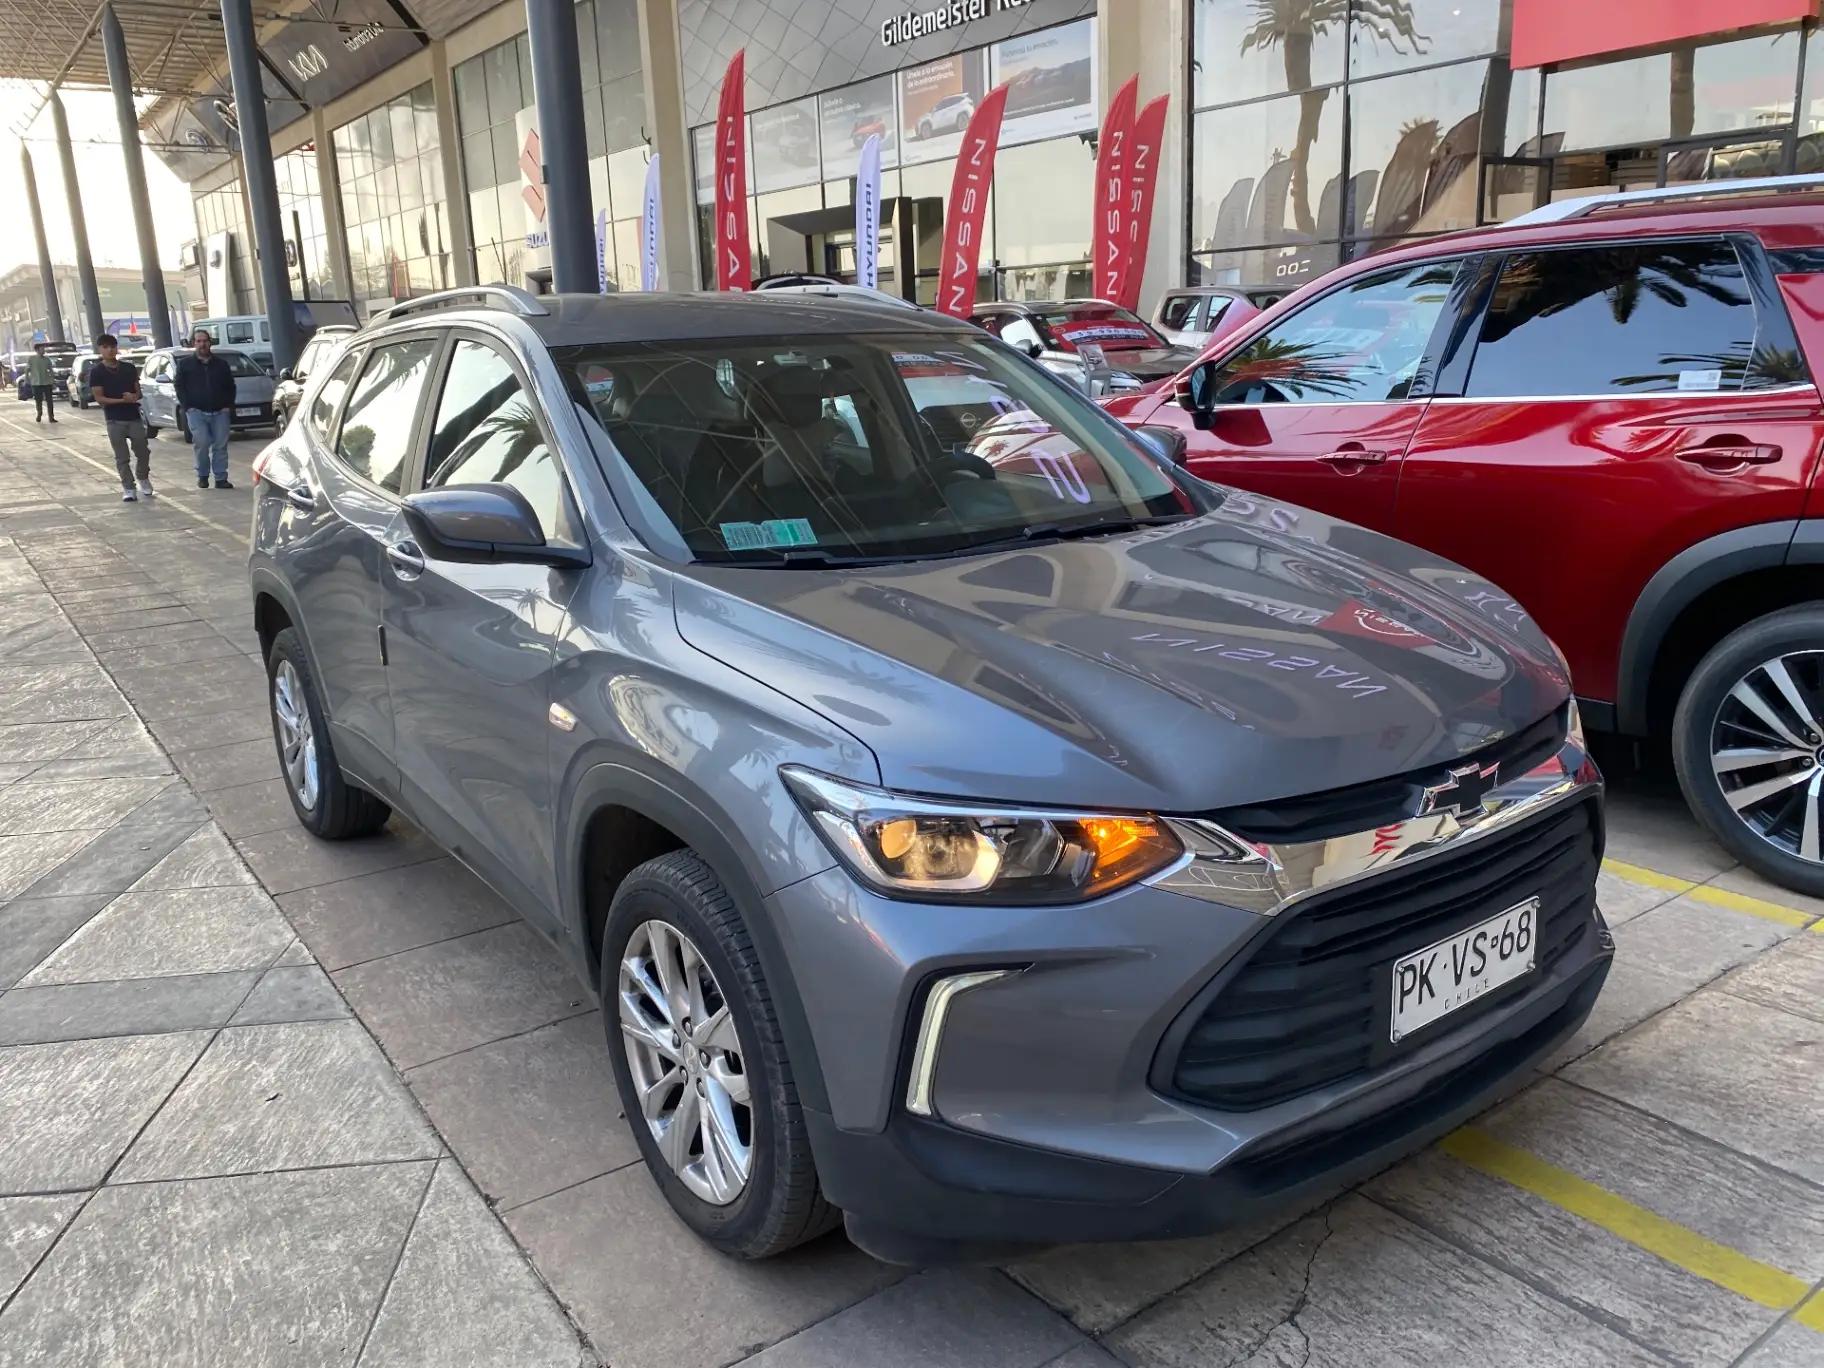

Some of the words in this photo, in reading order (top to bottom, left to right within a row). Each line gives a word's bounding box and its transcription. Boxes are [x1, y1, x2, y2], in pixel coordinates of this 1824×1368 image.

[881, 0, 987, 47] Gildemeister
[724, 115, 743, 293] NISSA
[948, 138, 987, 313] NISSAN
[1106, 131, 1124, 295] NISSAN
[1443, 977, 1490, 1010] CHILE
